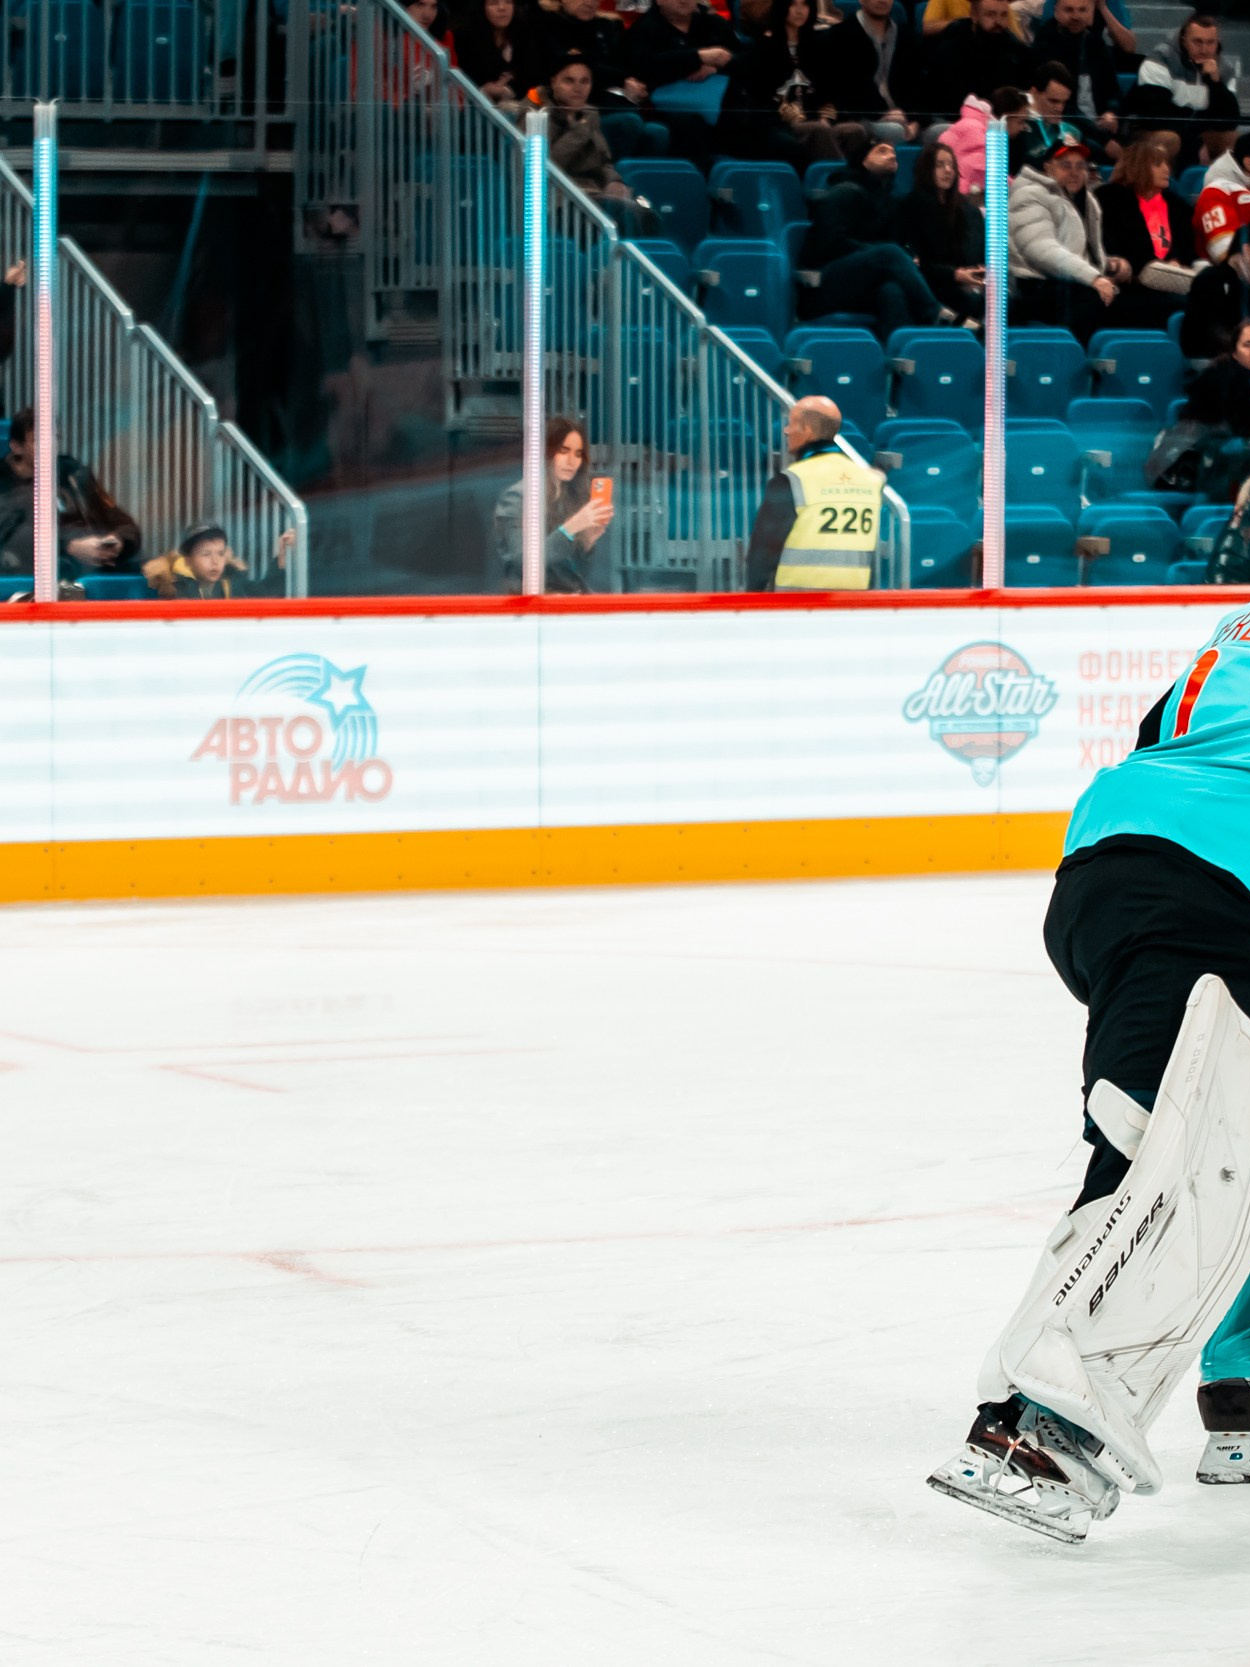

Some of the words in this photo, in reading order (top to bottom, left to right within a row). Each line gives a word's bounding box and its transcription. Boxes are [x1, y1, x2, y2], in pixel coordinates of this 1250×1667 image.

[1202, 205, 1227, 234] 63
[819, 507, 873, 534] 226
[1172, 649, 1219, 740] 1
[191, 715, 323, 761] АВТО
[230, 759, 393, 805] РАДИО
